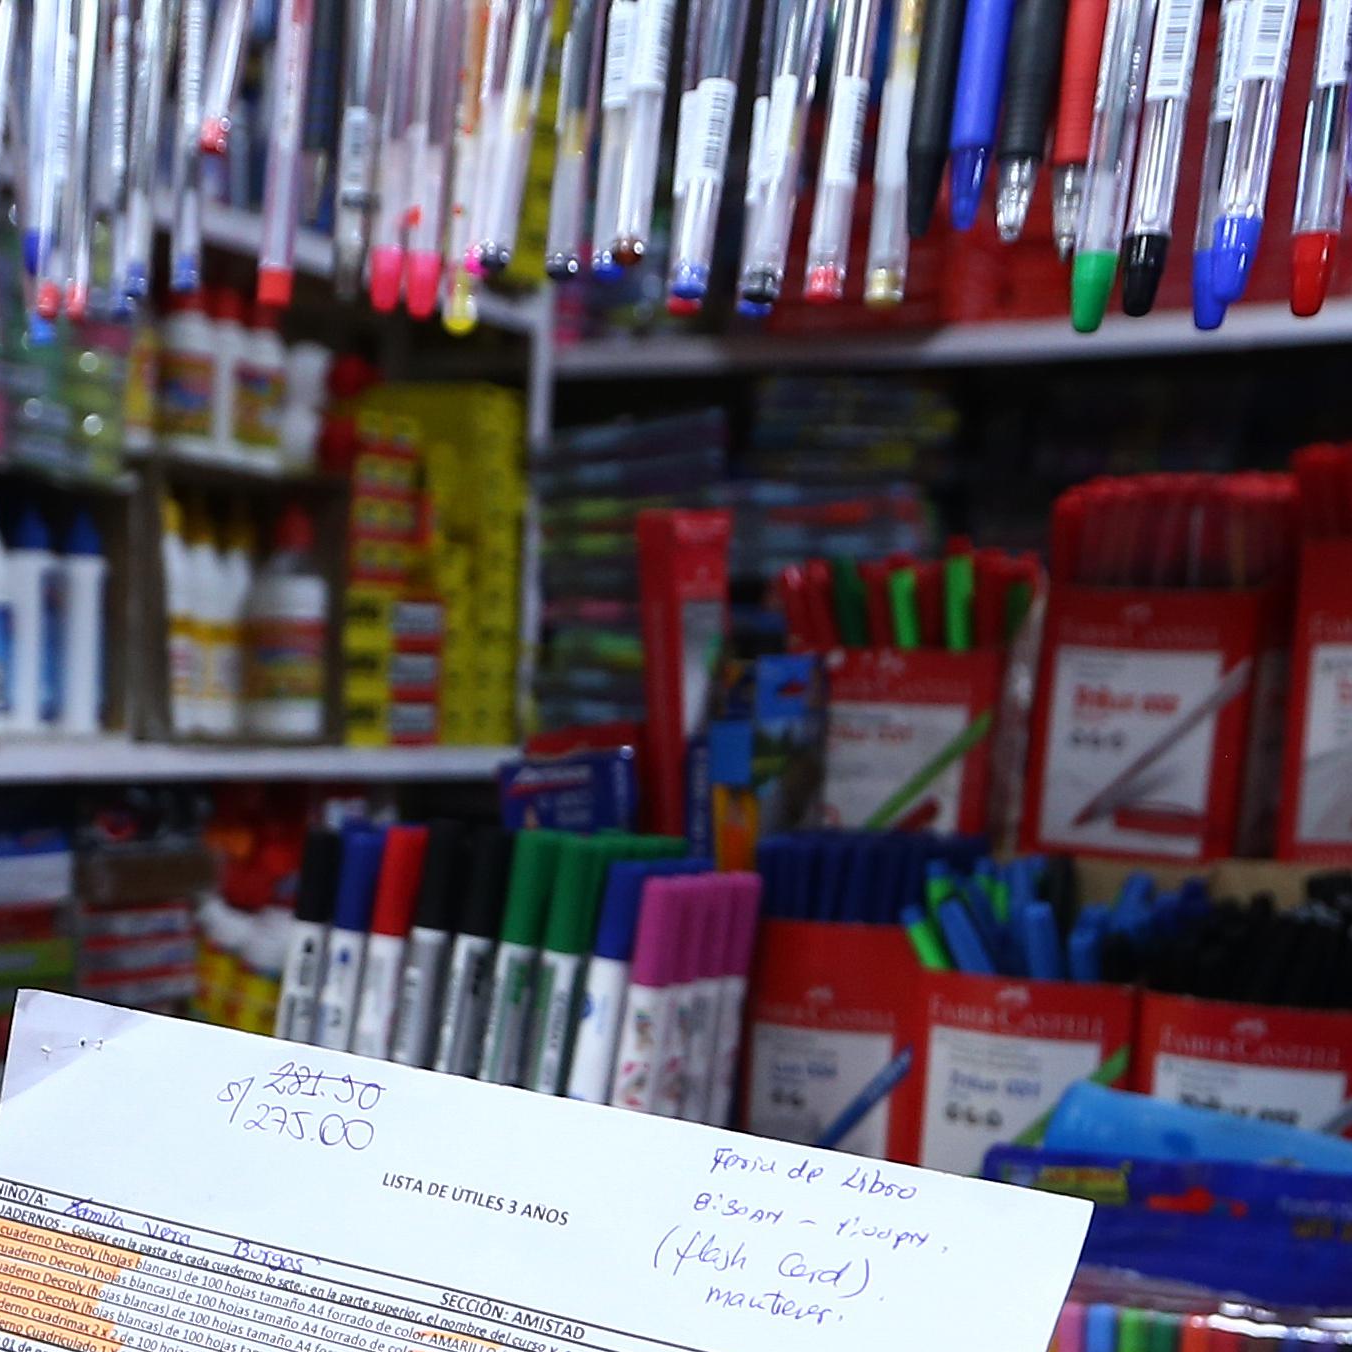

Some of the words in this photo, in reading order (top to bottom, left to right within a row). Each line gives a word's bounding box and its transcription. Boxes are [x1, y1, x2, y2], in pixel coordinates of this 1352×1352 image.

[243, 1104, 374, 1150] 275.00
[381, 1173, 427, 1194] LISTA
[427, 1183, 452, 1199] DE
[452, 1185, 508, 1211] ÚTILES
[521, 1202, 570, 1224] AÑOS
[439, 1291, 512, 1321] SECCIÓN:
[512, 1310, 586, 1339] AMISTAD
